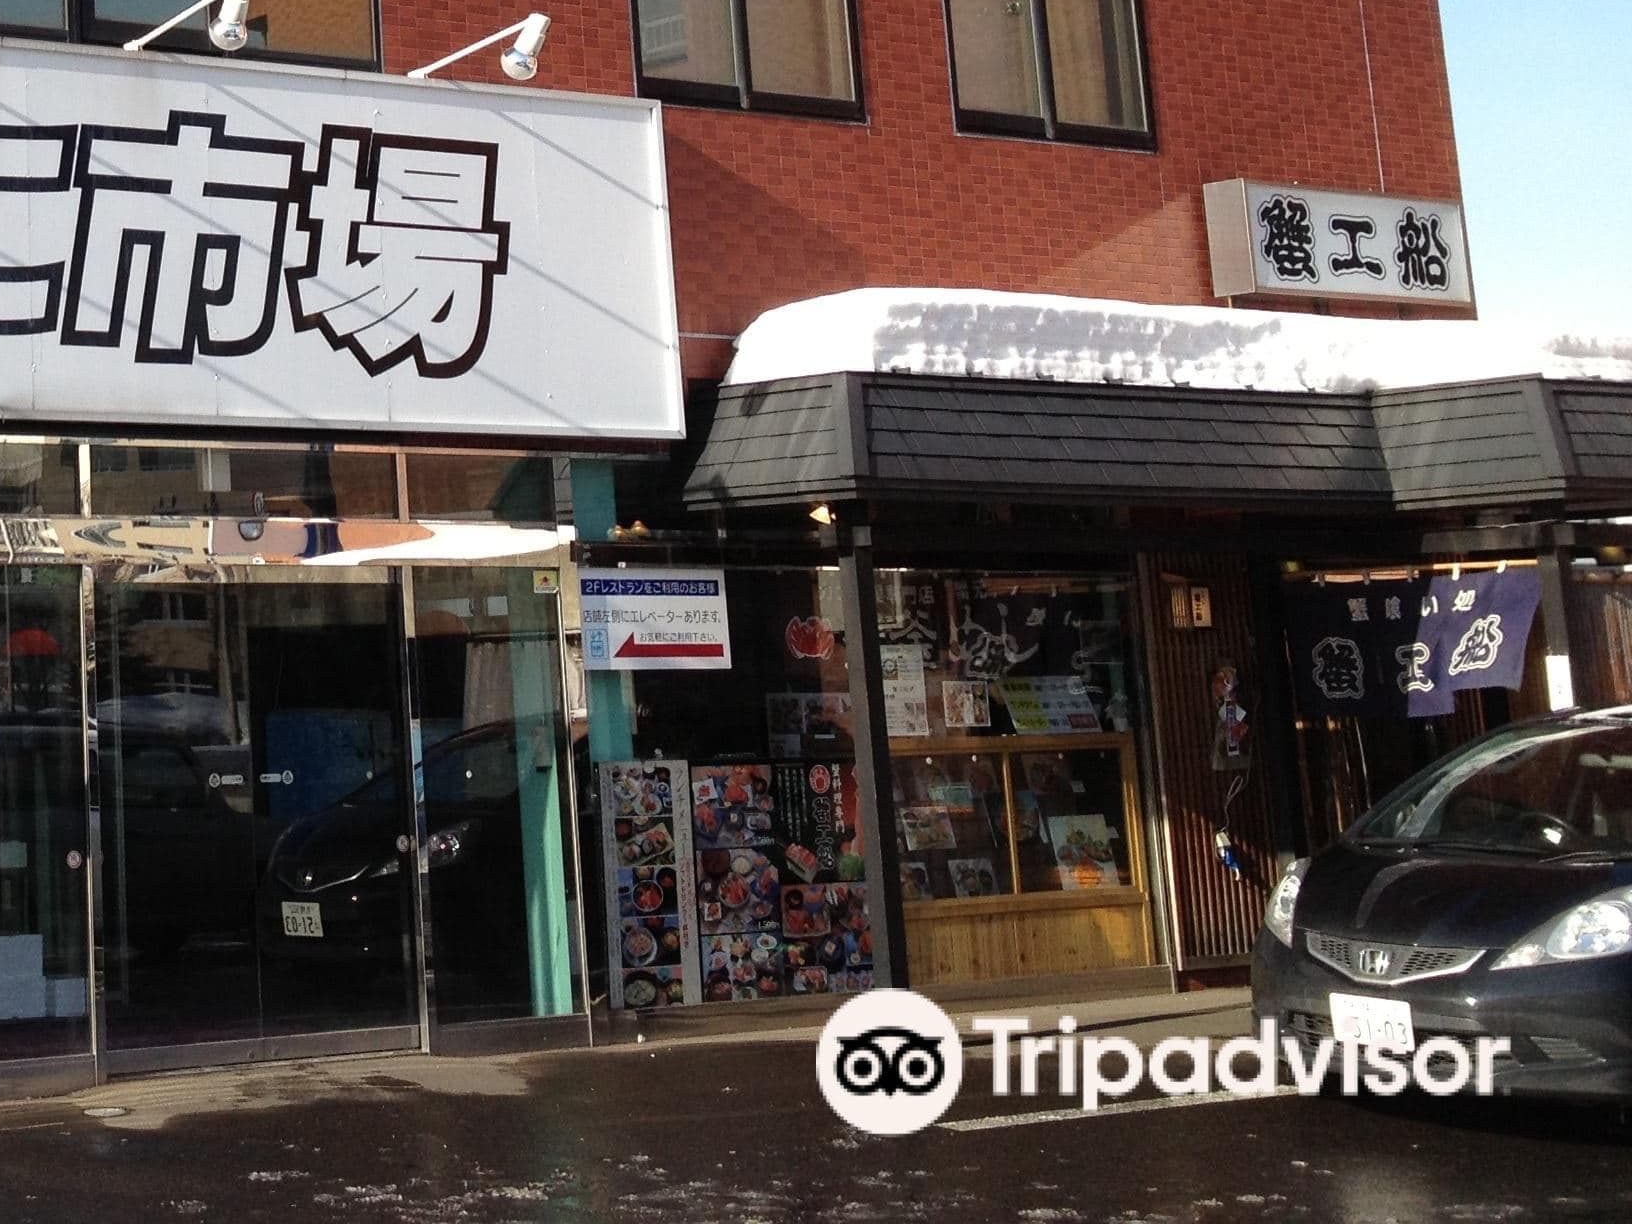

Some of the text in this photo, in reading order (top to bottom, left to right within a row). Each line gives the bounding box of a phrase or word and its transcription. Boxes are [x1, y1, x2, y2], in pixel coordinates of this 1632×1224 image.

[1258, 194, 1451, 290] 蟹工船
[585, 582, 716, 594] 2Fレストランをご利用のお客様
